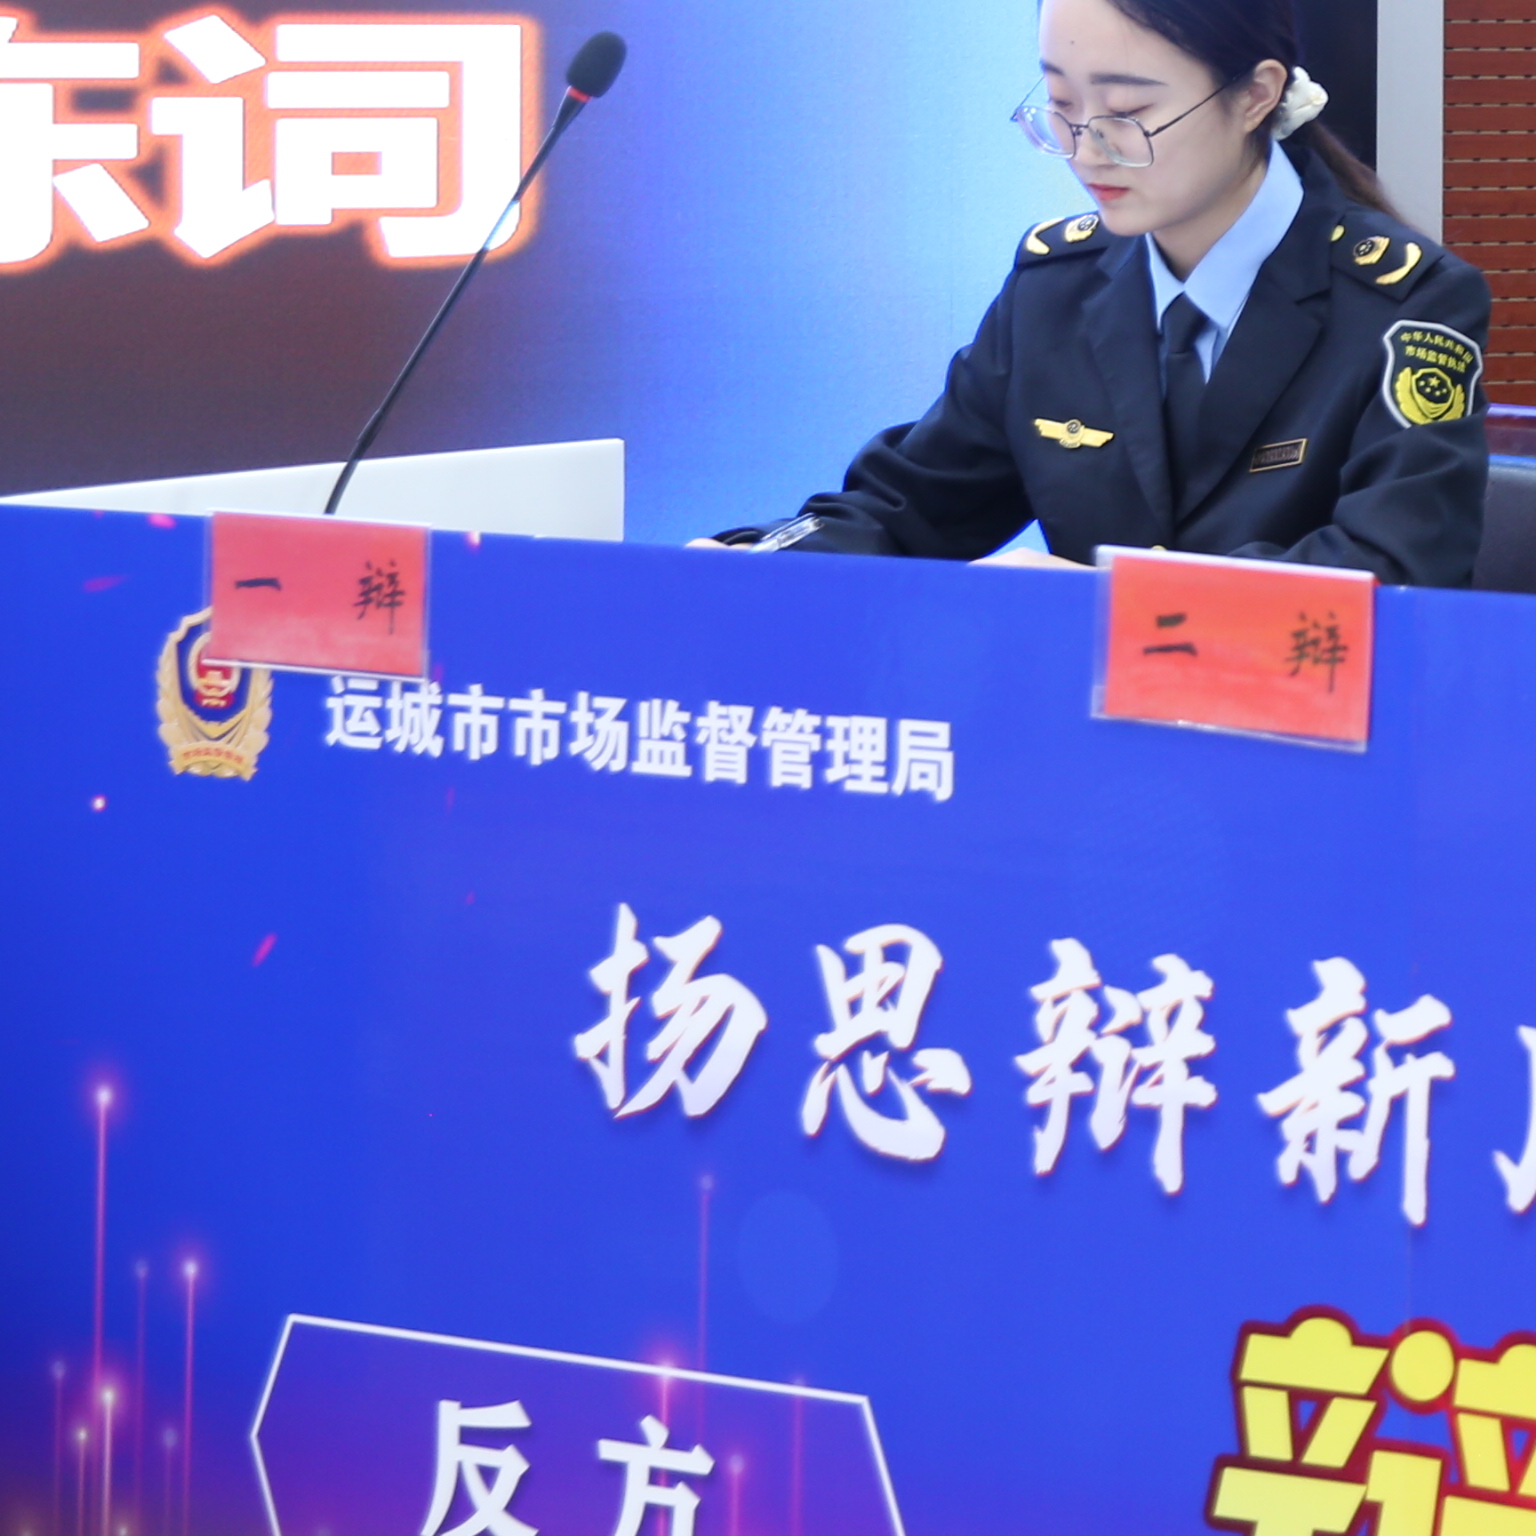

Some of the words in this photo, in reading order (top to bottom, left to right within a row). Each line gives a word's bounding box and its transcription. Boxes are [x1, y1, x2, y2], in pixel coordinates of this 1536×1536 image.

[326, 675, 955, 802] 运城市市场监督管理局
[419, 1399, 717, 1536] 反方
